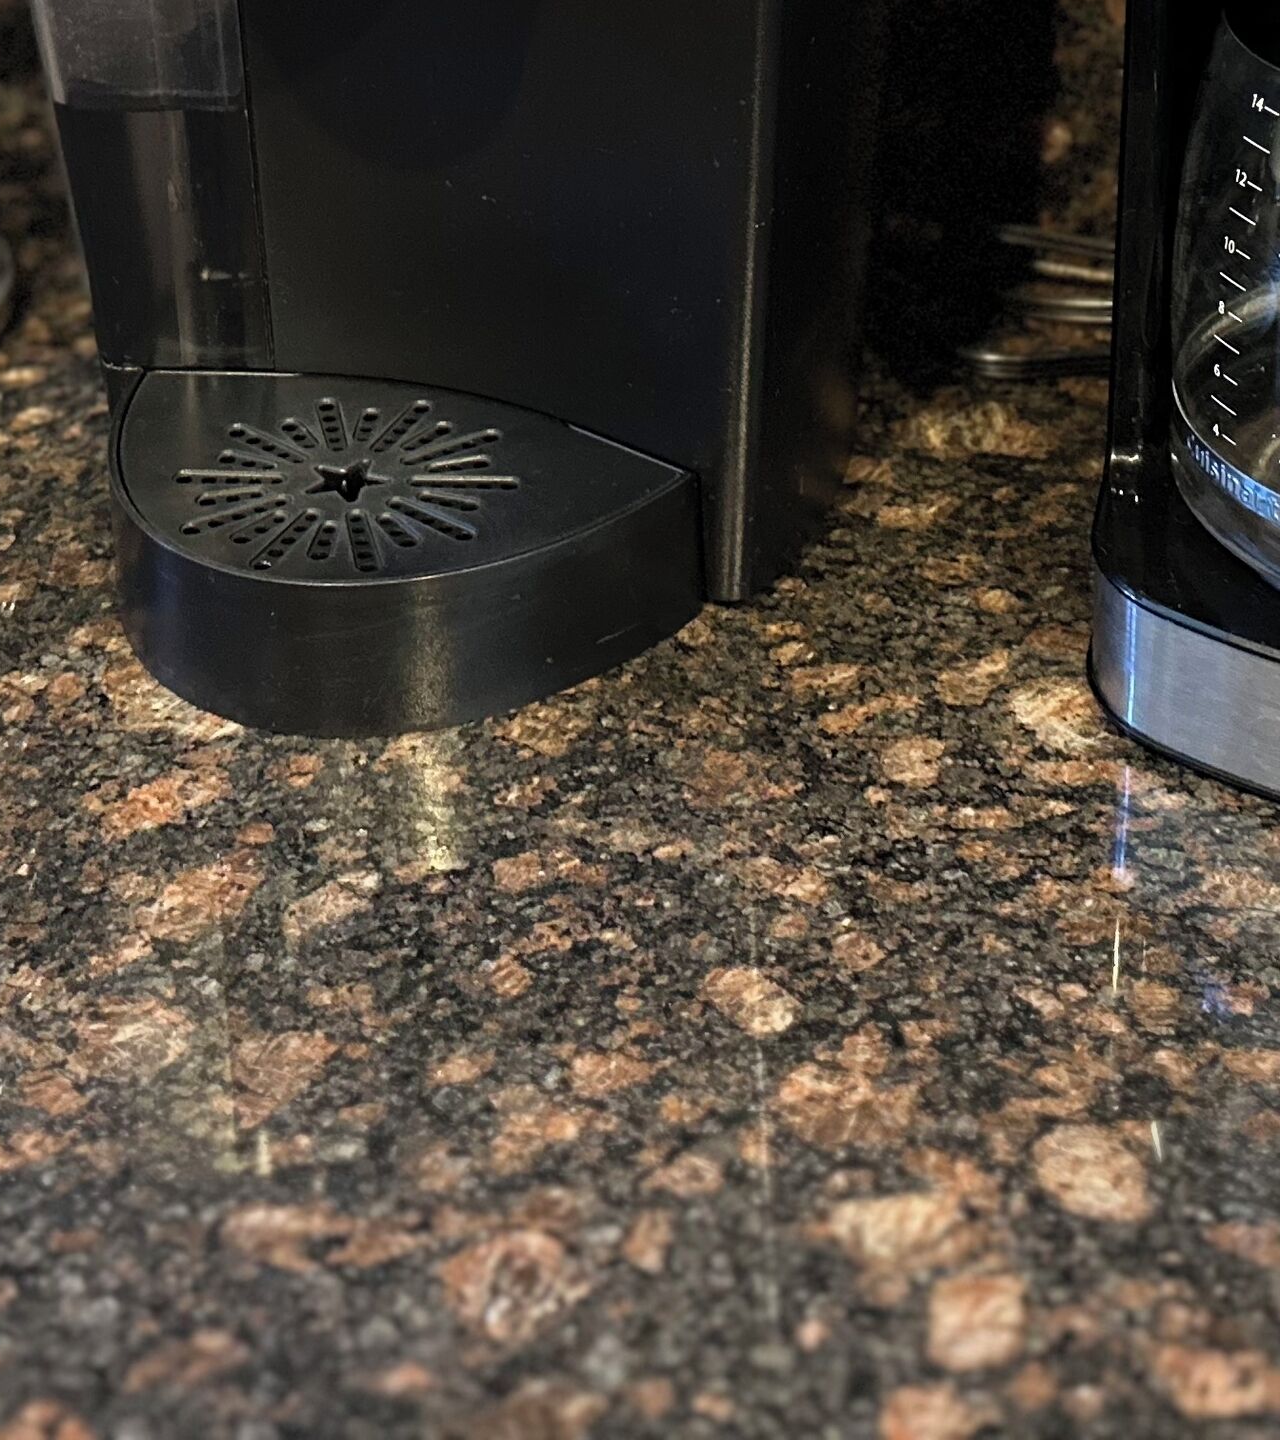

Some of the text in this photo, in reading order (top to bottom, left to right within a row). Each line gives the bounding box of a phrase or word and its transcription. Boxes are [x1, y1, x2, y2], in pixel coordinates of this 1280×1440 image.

[1251, 93, 1265, 112] 14
[1235, 168, 1248, 187] 12
[1224, 235, 1236, 254] 10
[1218, 300, 1225, 315] 8
[1213, 363, 1221, 377] 6
[1212, 423, 1220, 437] 4
[1186, 433, 1280, 522] Cuisinart
